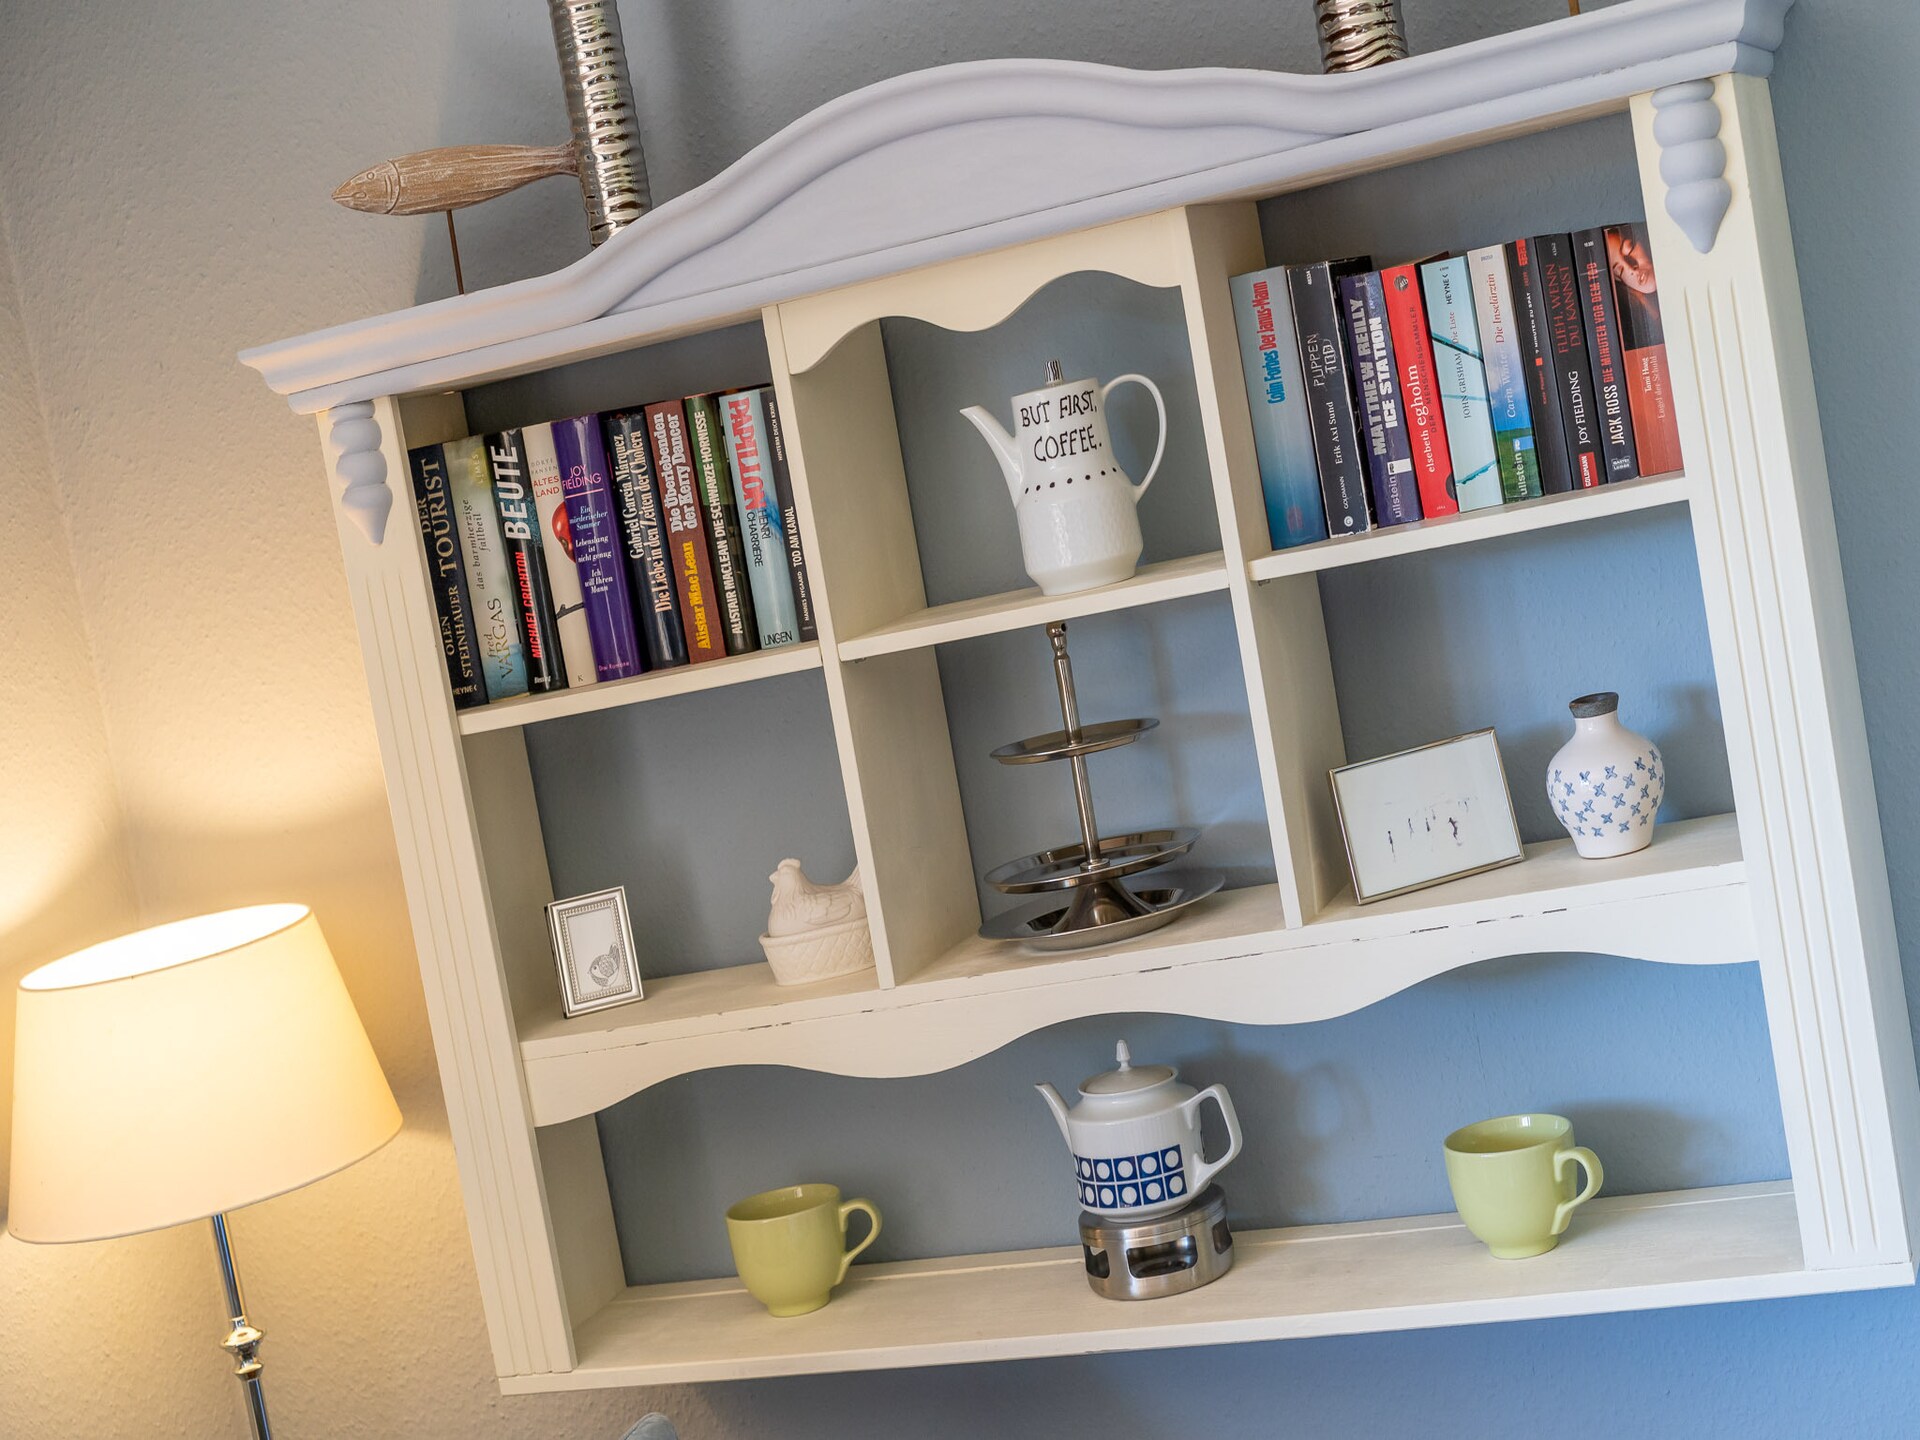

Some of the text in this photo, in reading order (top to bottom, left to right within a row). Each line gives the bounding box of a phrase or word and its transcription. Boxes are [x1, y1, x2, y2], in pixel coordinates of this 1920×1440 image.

[1545, 263, 1562, 309] WENN
[1586, 261, 1599, 281] TOD
[1442, 278, 1453, 305] HEYNE
[1486, 273, 1501, 324] Inselärztin
[1558, 266, 1581, 347] DU KANNST
[1590, 281, 1602, 304] DEM
[1349, 298, 1371, 357] REILLY
[1449, 311, 1459, 344] Die Liste
[1592, 305, 1605, 324] VOR
[1252, 281, 1286, 404] Colin Forbes Der Janus-Mann
[1495, 326, 1505, 344] Die
[1595, 324, 1612, 366] MINUTEN
[1306, 333, 1325, 387] PUPPEN
[1368, 316, 1398, 429] ICE STATION
[1602, 366, 1615, 384] DIE
[1455, 353, 1471, 419] JOHN GRISHAM
[1505, 388, 1516, 418] Carin
[1643, 376, 1652, 394] Tami
[1020, 389, 1097, 427] BUT FIRST,
[1360, 361, 1387, 456] MATTHEW
[1407, 364, 1435, 473] elsebeth egholm
[1428, 415, 1437, 433] DER
[1568, 370, 1591, 445] JOY FIELDING
[1603, 384, 1625, 446] JACK ROSS
[1033, 423, 1102, 462] COFFEE.
[1326, 401, 1343, 465] Erik Axl Sund
[569, 464, 586, 478] JOY
[613, 434, 630, 482] Márquez
[653, 412, 684, 533] Die Überlebenden
[667, 413, 698, 529] der Kerry Dancer
[728, 397, 767, 510] PAPILLON
[1581, 455, 1592, 487] GOLDMANN
[491, 445, 531, 540] BEUTE
[533, 475, 559, 487] ALTES
[535, 486, 560, 498] LAND
[562, 472, 601, 490] FIELDING
[1340, 476, 1349, 510] GOLDMANN
[1515, 452, 1528, 496] ullstein
[417, 497, 432, 534] DER
[580, 505, 591, 514] Ein
[1388, 476, 1402, 518] ullstein
[421, 458, 457, 578] TOURIST
[473, 513, 491, 552] fallbeil
[576, 520, 601, 531] Sommer
[629, 430, 672, 612] Die Liebe in den Zeiten der Cholera
[694, 410, 743, 634] ALISTAIR MACLEAN DIE SCHWARZE HORNISSE
[757, 509, 771, 539] HENRI
[784, 506, 799, 537] KANAL
[463, 499, 485, 590] das barmherzige
[575, 535, 608, 548] Lebenslang
[577, 551, 612, 563] nicht genug
[588, 545, 596, 553] ist
[625, 519, 644, 559] Gabriel
[789, 535, 801, 550] AM
[591, 568, 602, 577] Ich
[791, 549, 803, 568] TOD
[584, 576, 613, 588] will Ihren
[590, 585, 608, 594] Mann
[515, 551, 542, 659] MICHAEL CRICHTON
[801, 598, 810, 621] HANNES
[440, 616, 455, 656] OLEN
[448, 584, 474, 678] STEINHAUER
[484, 634, 497, 658] fred
[487, 598, 513, 679] VARGAS
[763, 630, 793, 646] LINGEN
